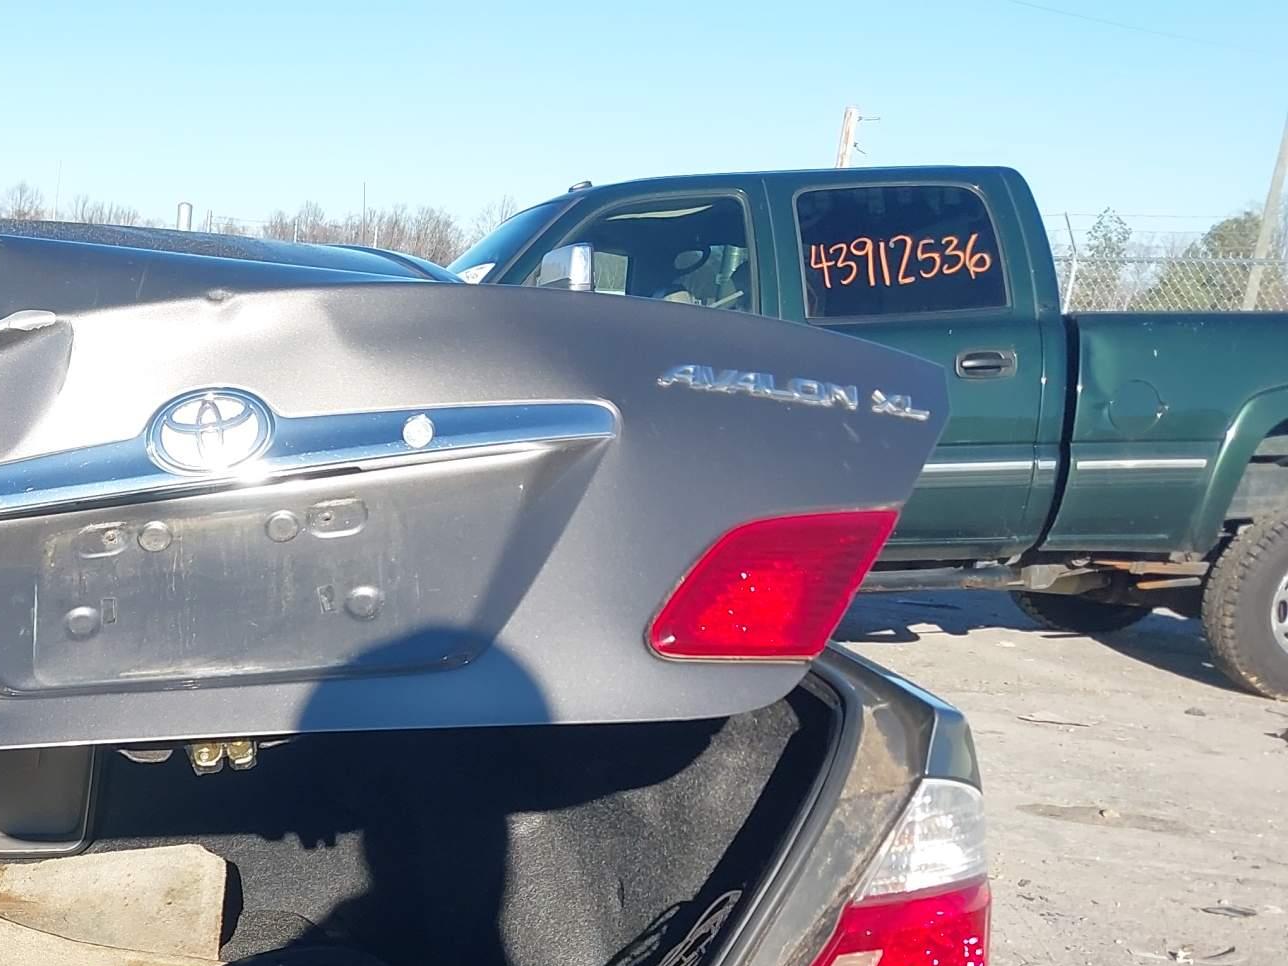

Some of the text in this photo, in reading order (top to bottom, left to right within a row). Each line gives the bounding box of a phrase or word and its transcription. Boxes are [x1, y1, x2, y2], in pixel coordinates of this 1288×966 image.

[810, 232, 992, 288] 43912536
[657, 364, 931, 421] AVALON XL
